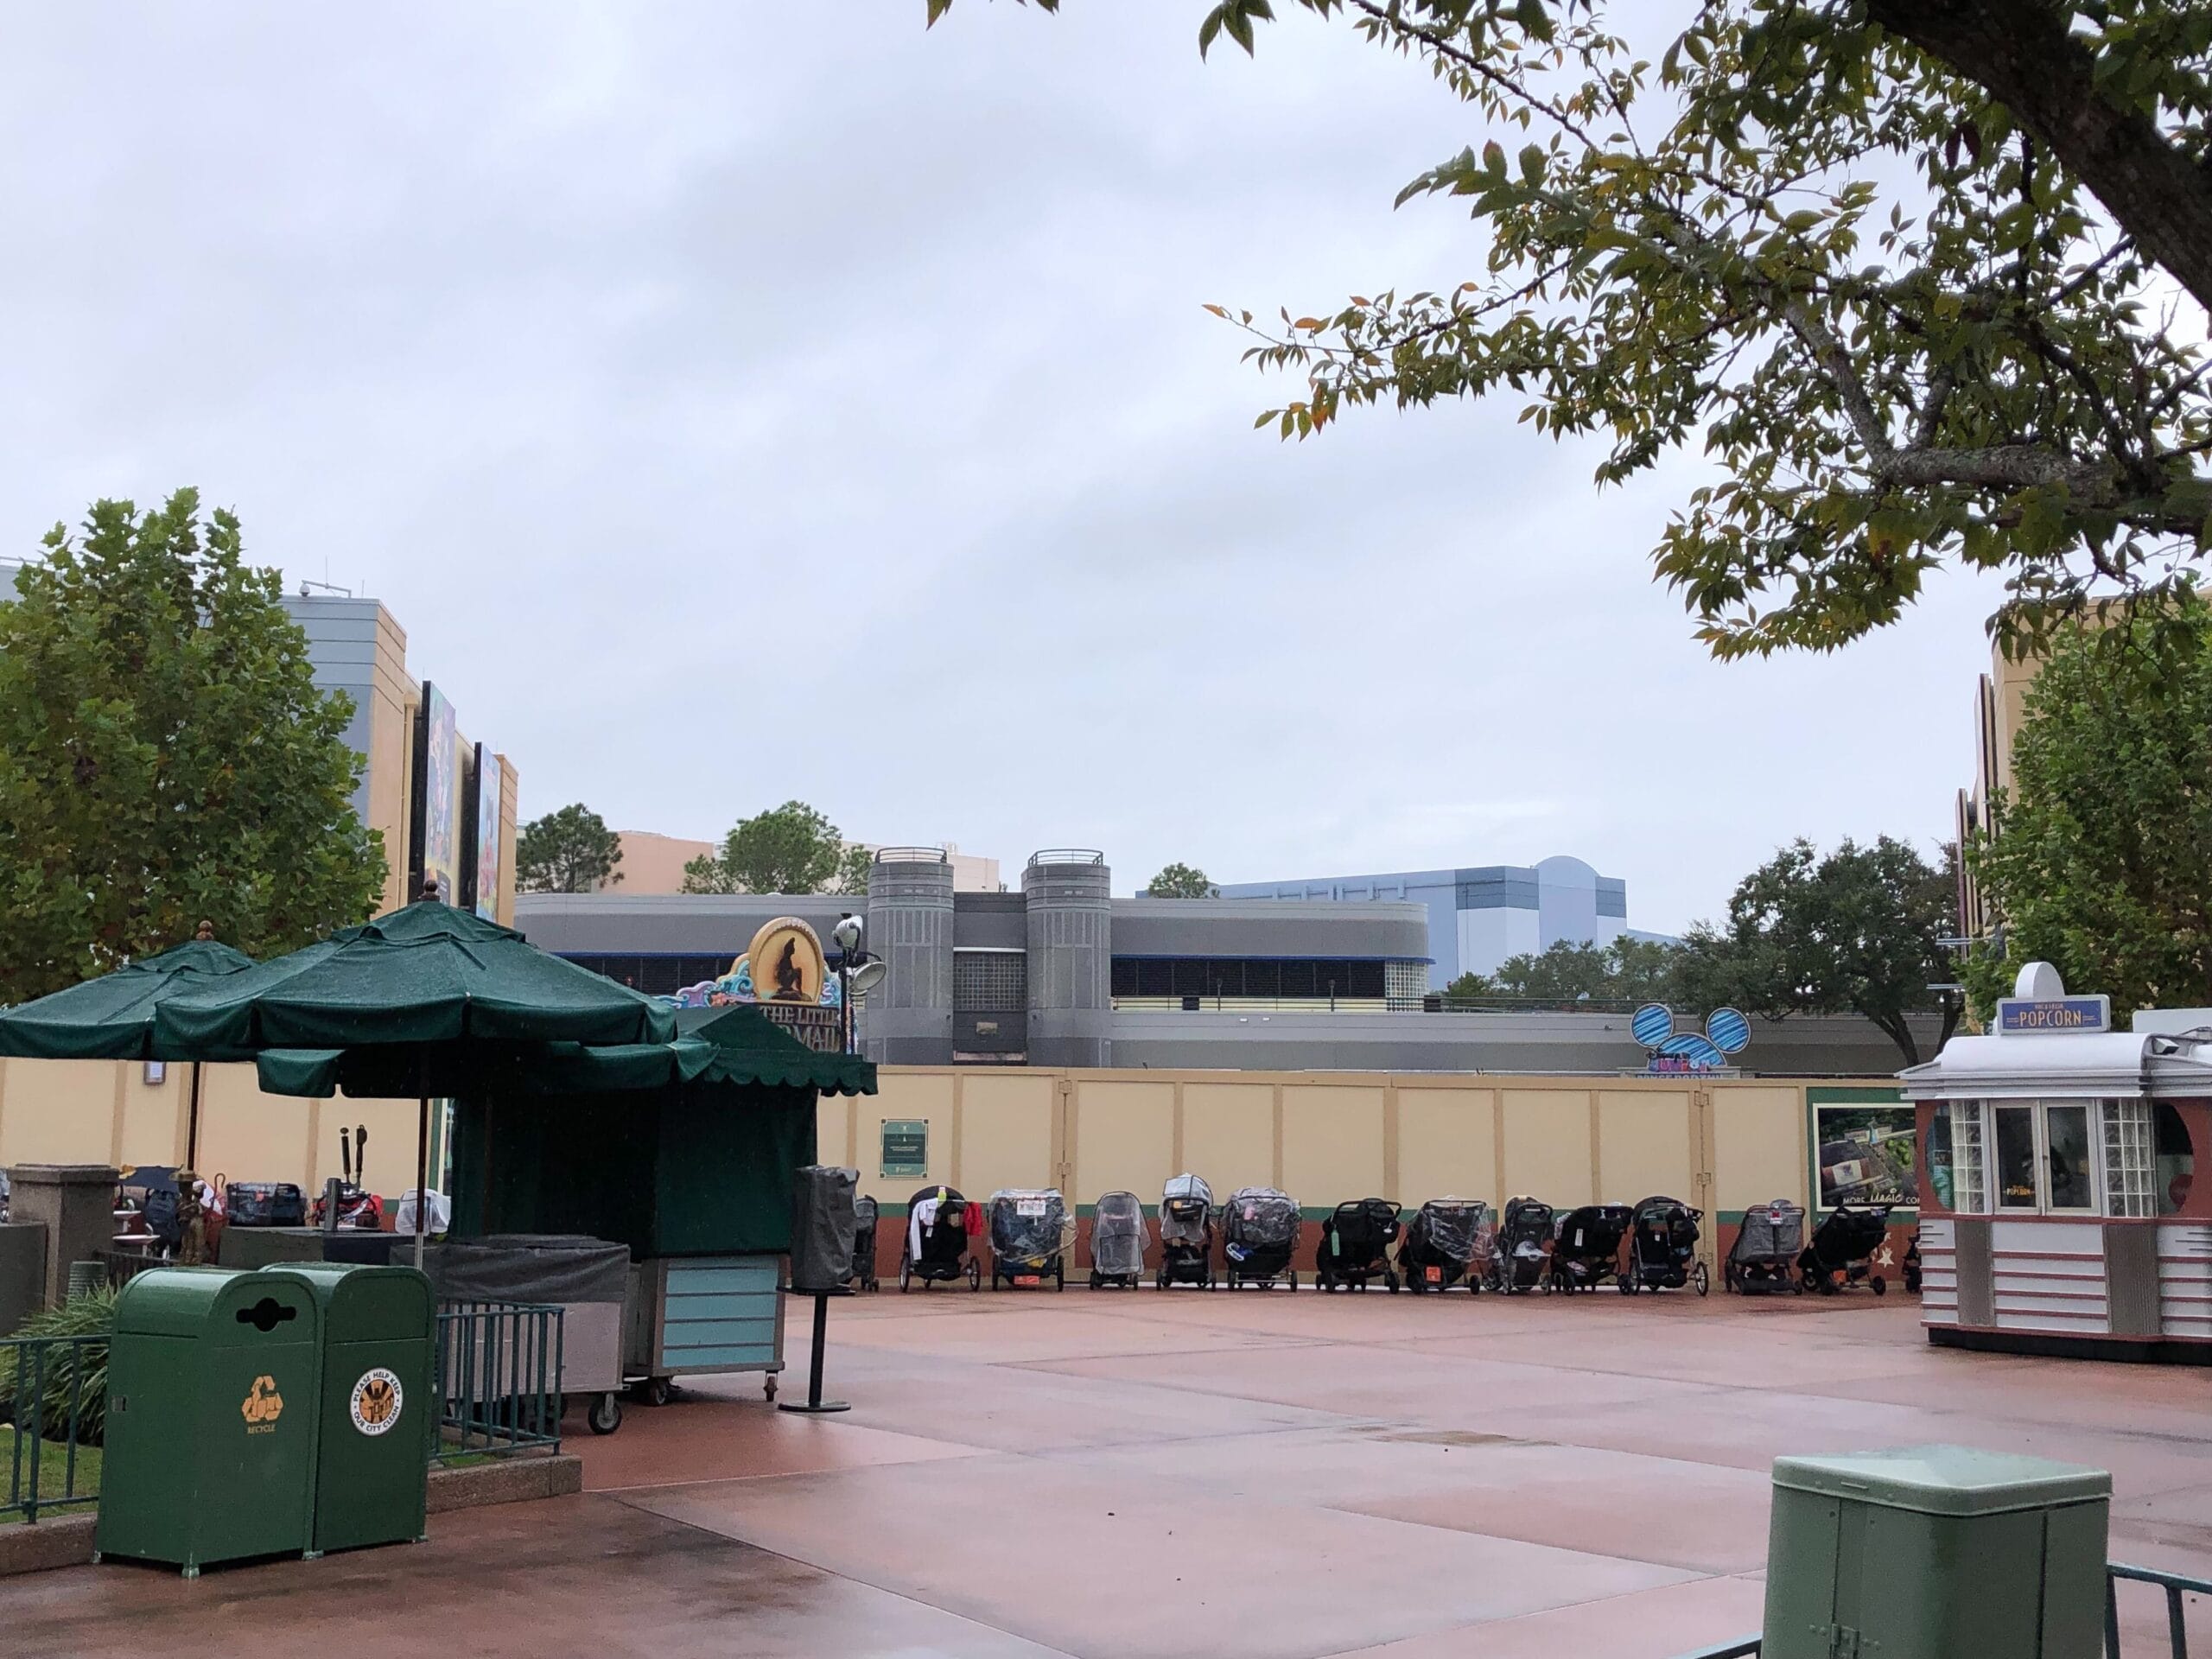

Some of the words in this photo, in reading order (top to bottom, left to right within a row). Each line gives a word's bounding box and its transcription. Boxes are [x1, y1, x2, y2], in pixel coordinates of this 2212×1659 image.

[760, 1005, 795, 1024] THE
[798, 1007, 838, 1027] LITTLE
[2019, 1009, 2082, 1027] POPCORN
[777, 1025, 841, 1053] MAID
[1870, 1191, 1903, 1204] MAGIC
[353, 1375, 372, 1402] PLEASE
[390, 1377, 401, 1395] KEEP
[354, 1411, 365, 1427] OUR
[383, 1405, 399, 1427] CLEAN
[247, 1424, 276, 1434] RECYCLE
